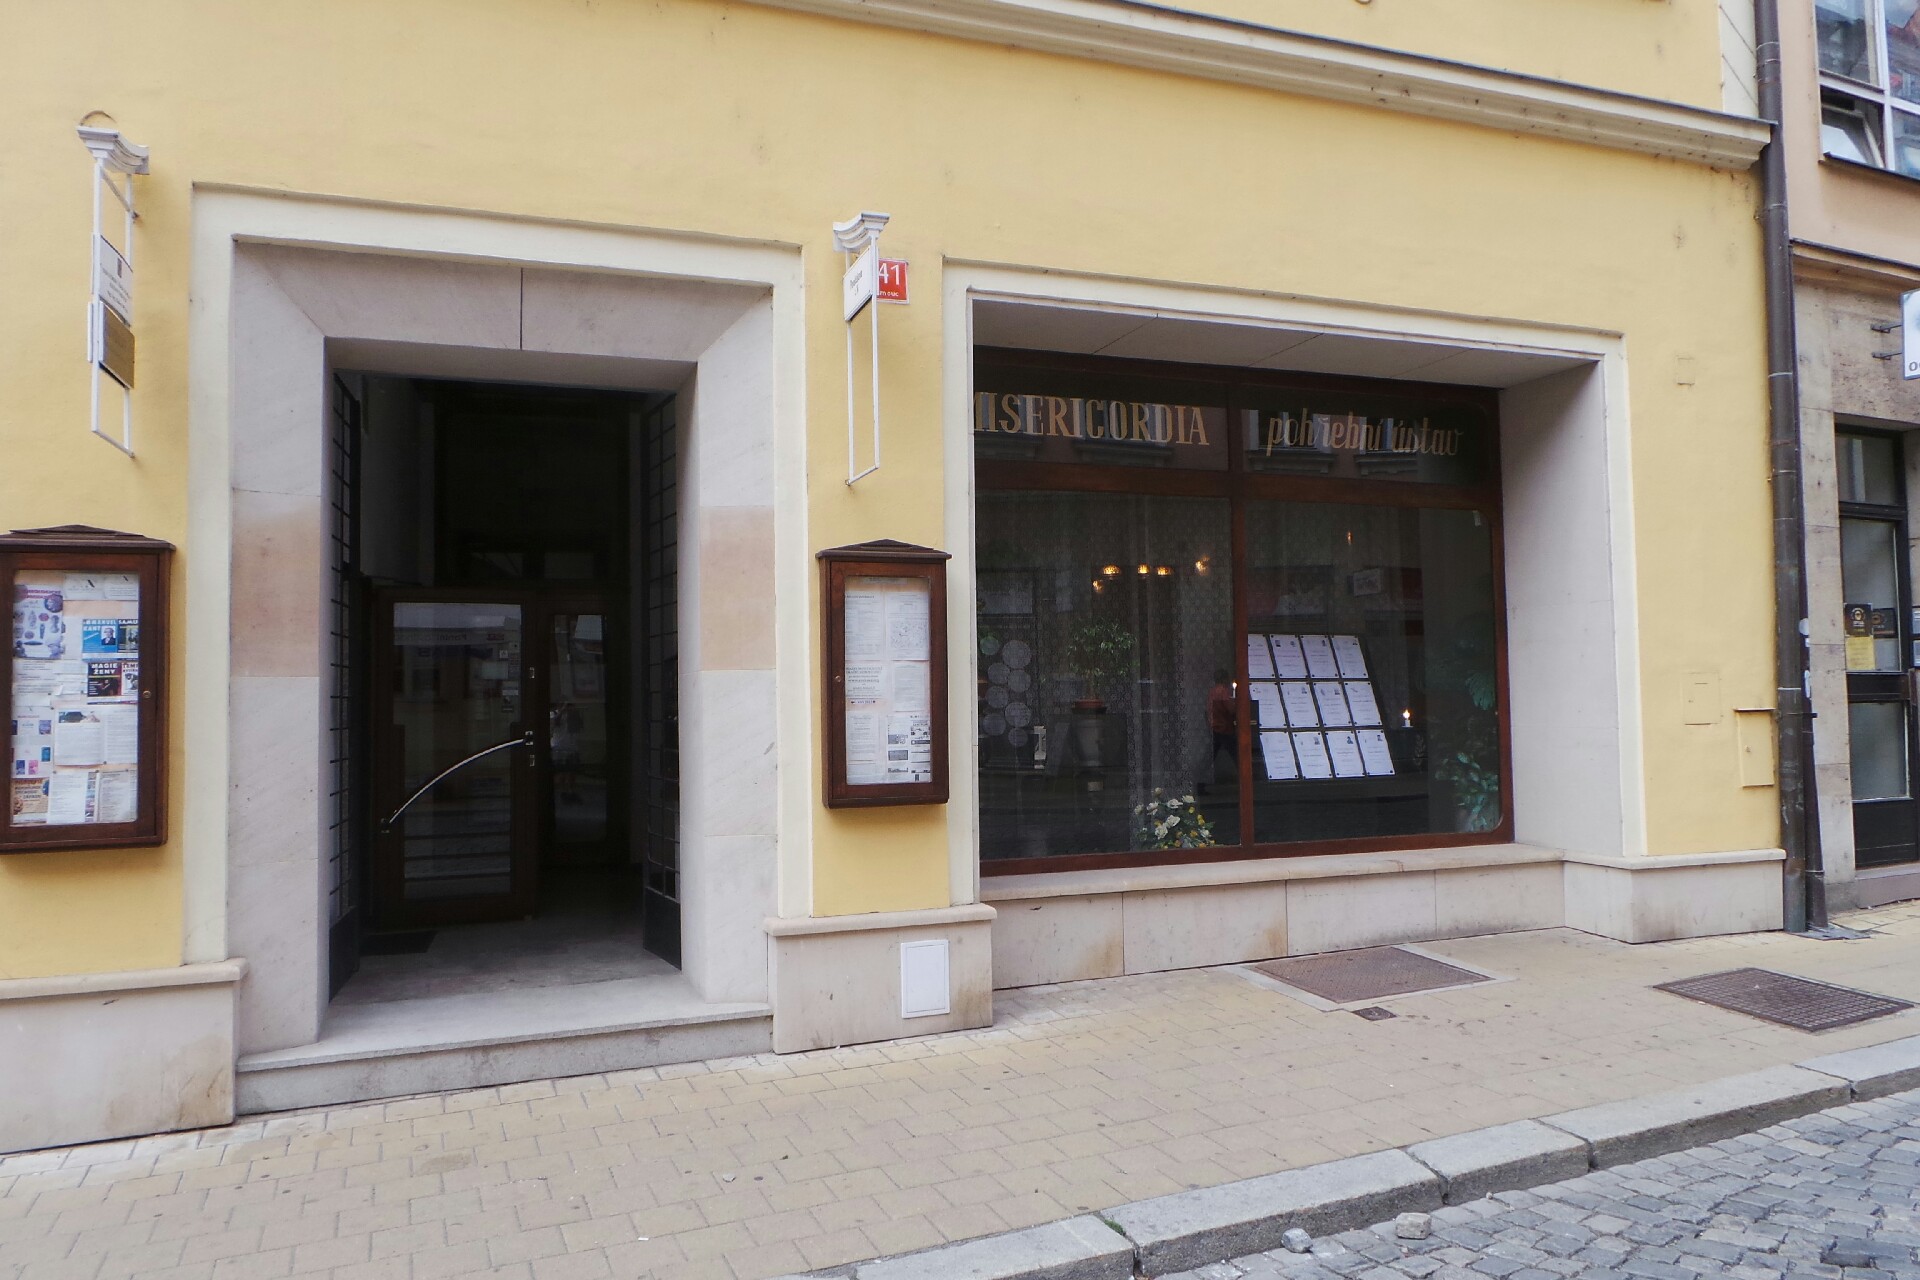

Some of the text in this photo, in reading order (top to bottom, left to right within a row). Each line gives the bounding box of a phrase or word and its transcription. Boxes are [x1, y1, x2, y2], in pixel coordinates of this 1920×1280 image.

[879, 262, 900, 286] 41
[1266, 408, 1465, 457] pohřební ústav
